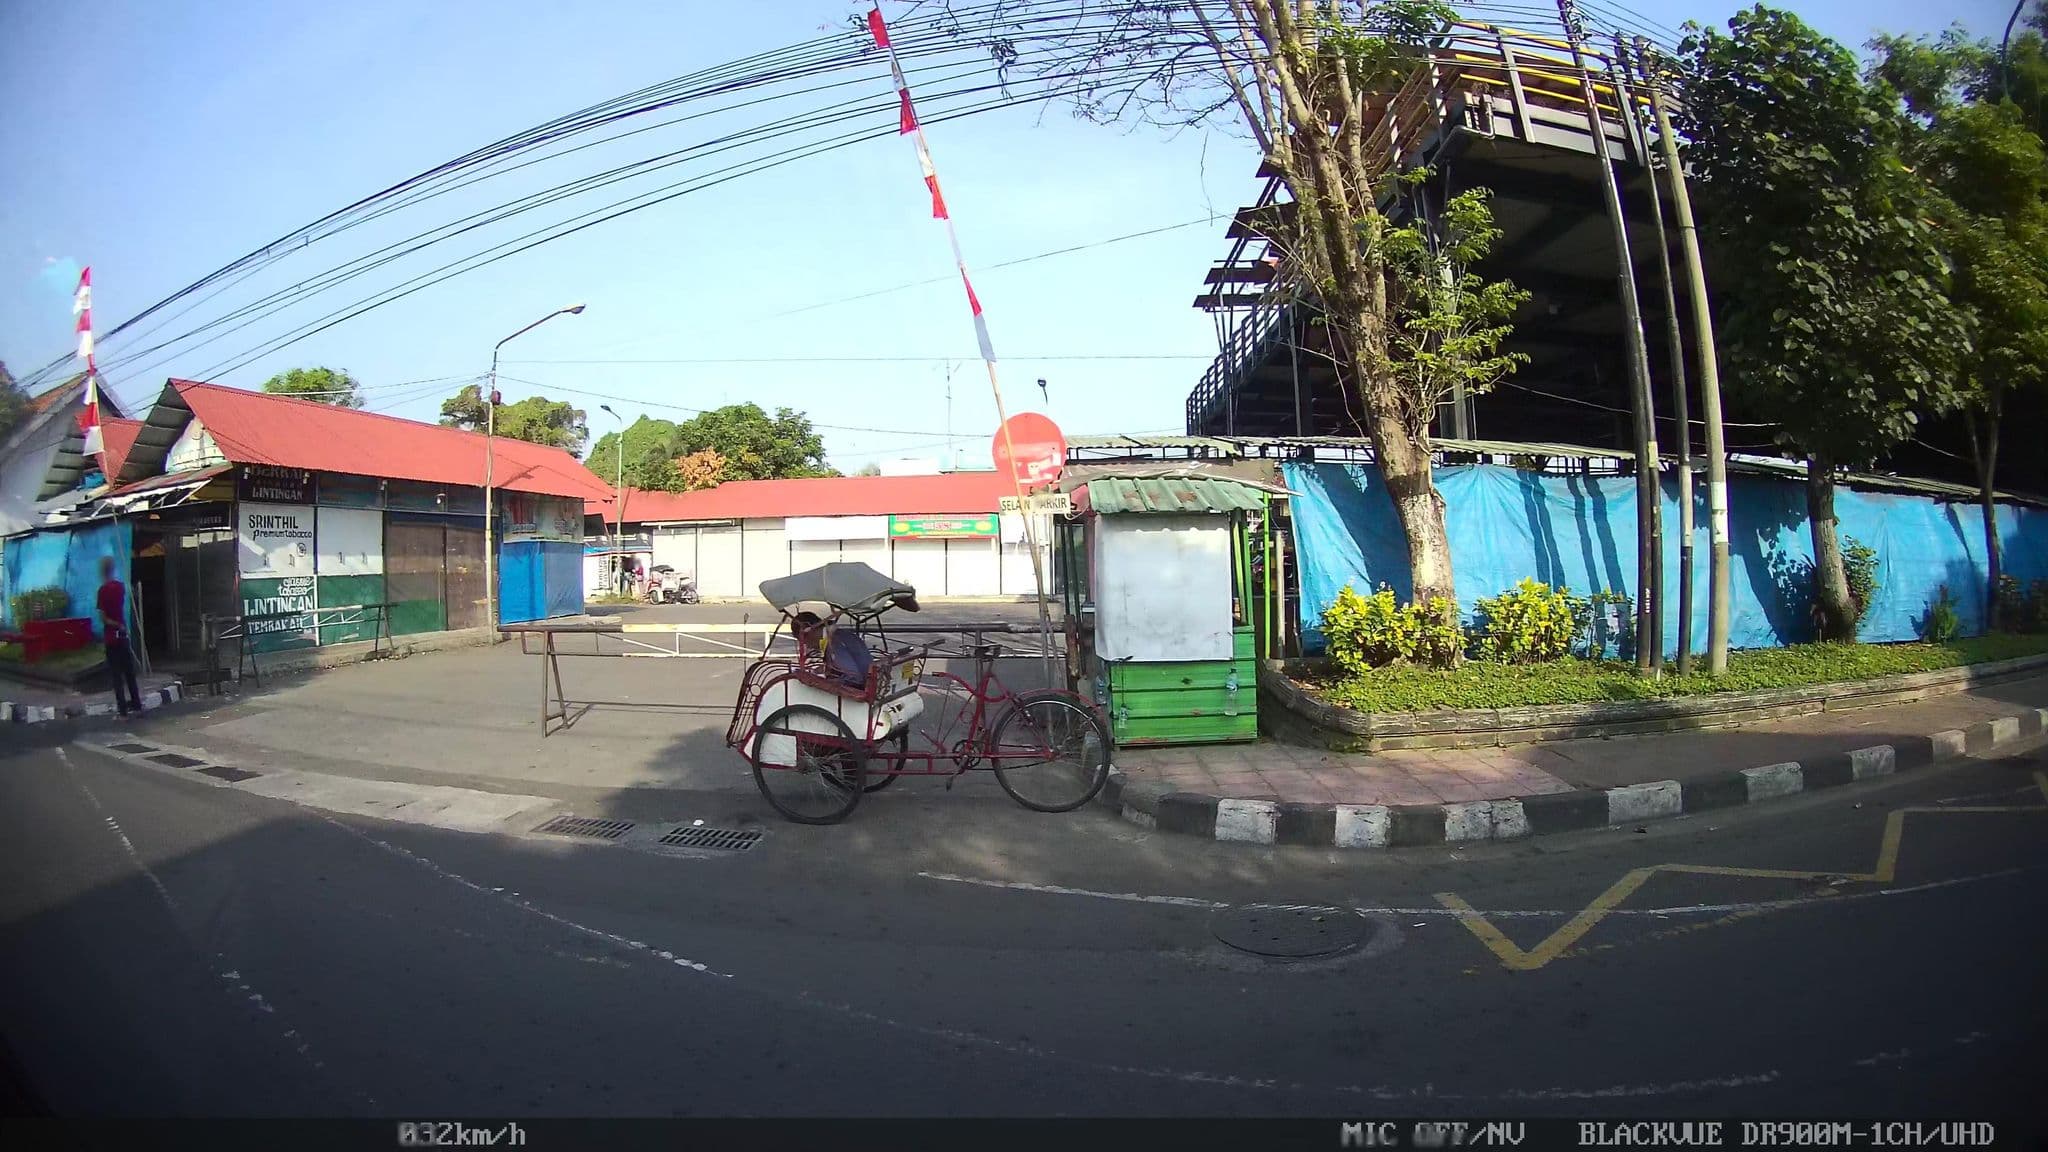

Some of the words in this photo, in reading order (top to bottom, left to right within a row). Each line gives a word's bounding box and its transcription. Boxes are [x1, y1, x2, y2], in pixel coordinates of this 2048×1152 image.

[252, 487, 303, 500] LINTINGAN
[1001, 500, 1030, 511] SELAN
[1037, 498, 1067, 509] ARKIR
[248, 514, 298, 529] SRINTHIL
